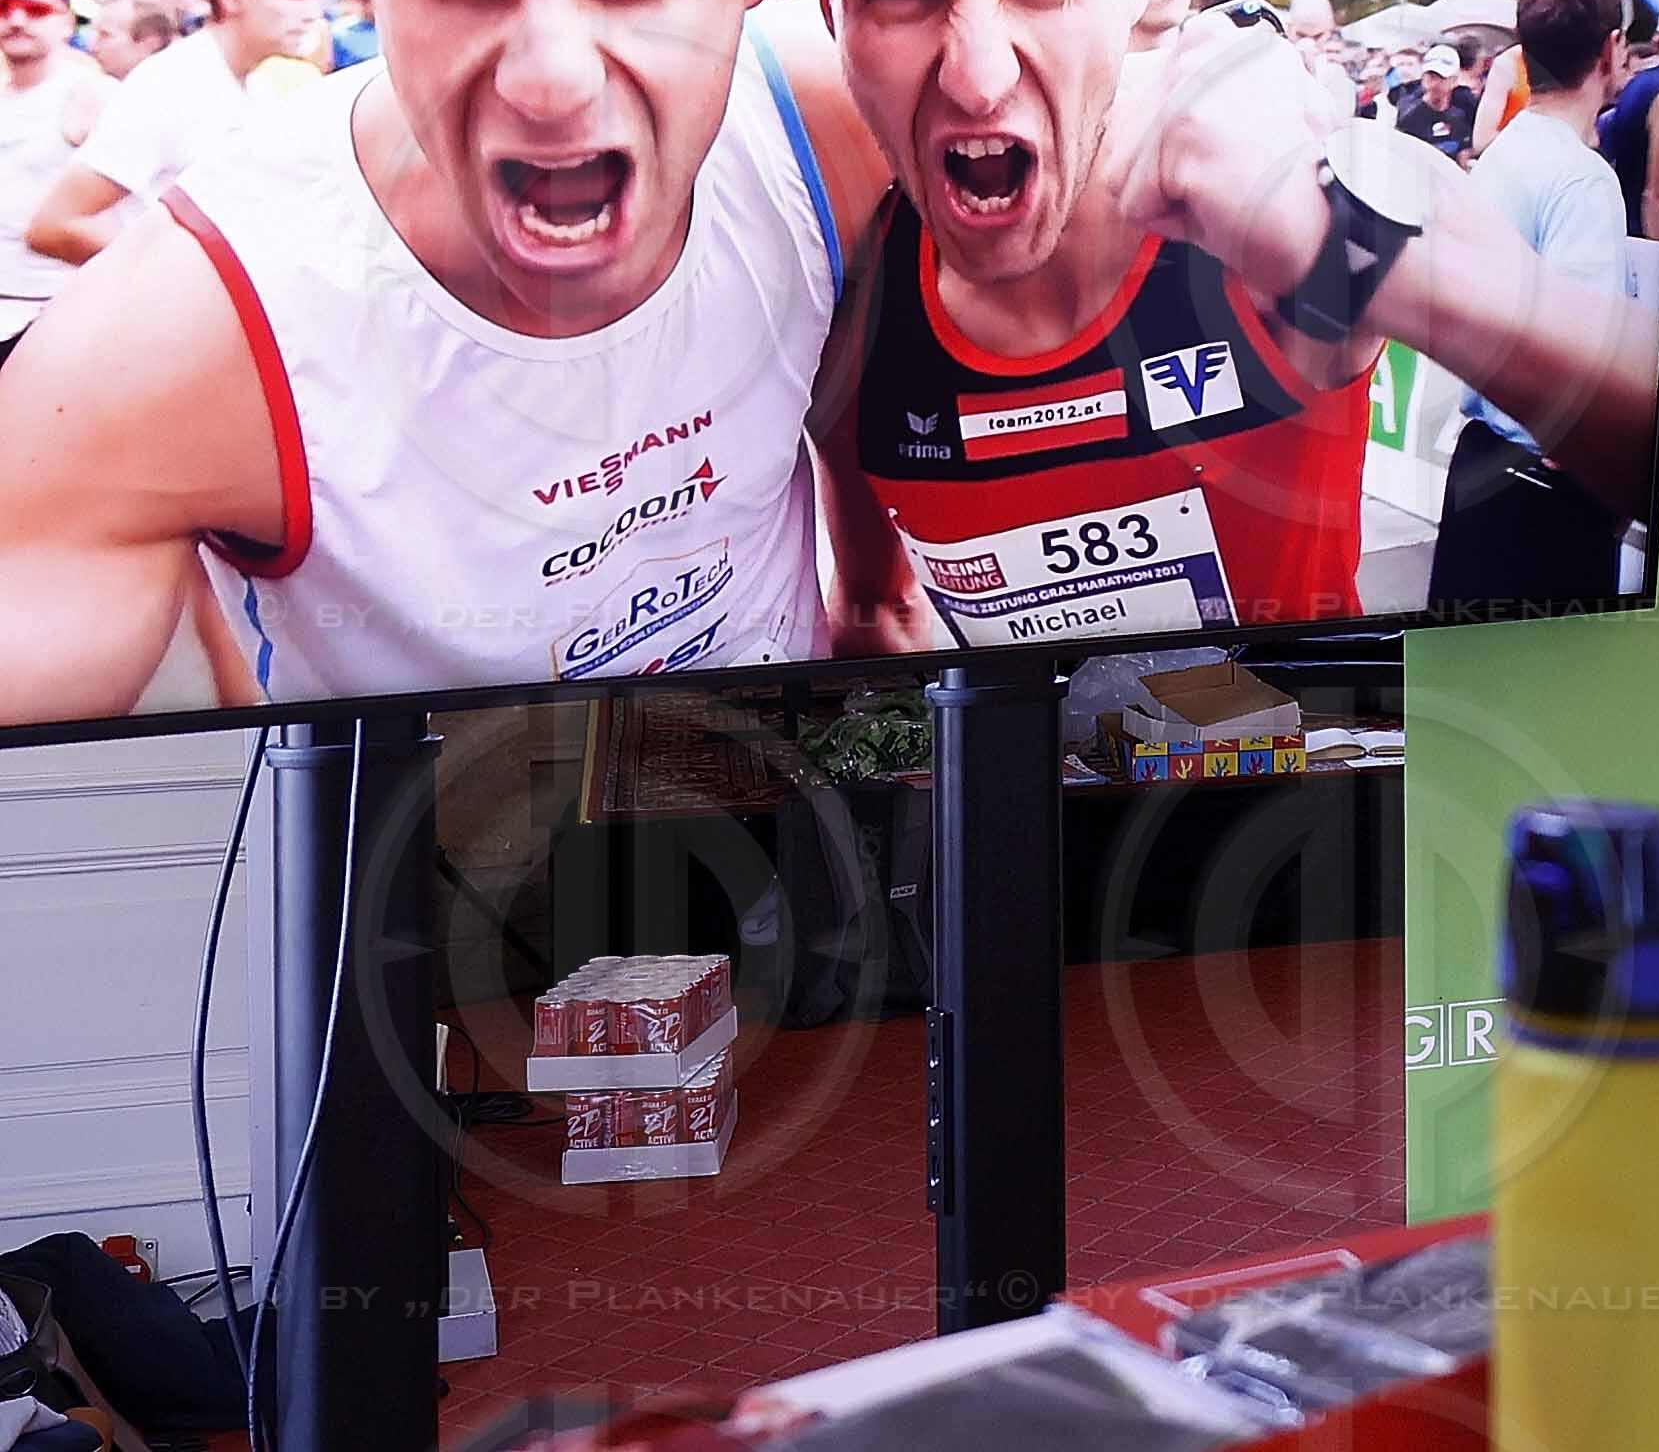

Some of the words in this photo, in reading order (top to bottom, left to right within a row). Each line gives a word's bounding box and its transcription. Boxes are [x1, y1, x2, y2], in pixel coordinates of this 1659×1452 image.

[928, 556, 997, 576] KLEINE
[1041, 513, 1159, 574] 583
[980, 591, 1039, 614] ZEITUNG
[1039, 583, 1078, 600] GRAZ
[1078, 570, 1154, 593] MARATHON
[1154, 563, 1185, 579] 2017
[1008, 598, 1127, 640] Michael
